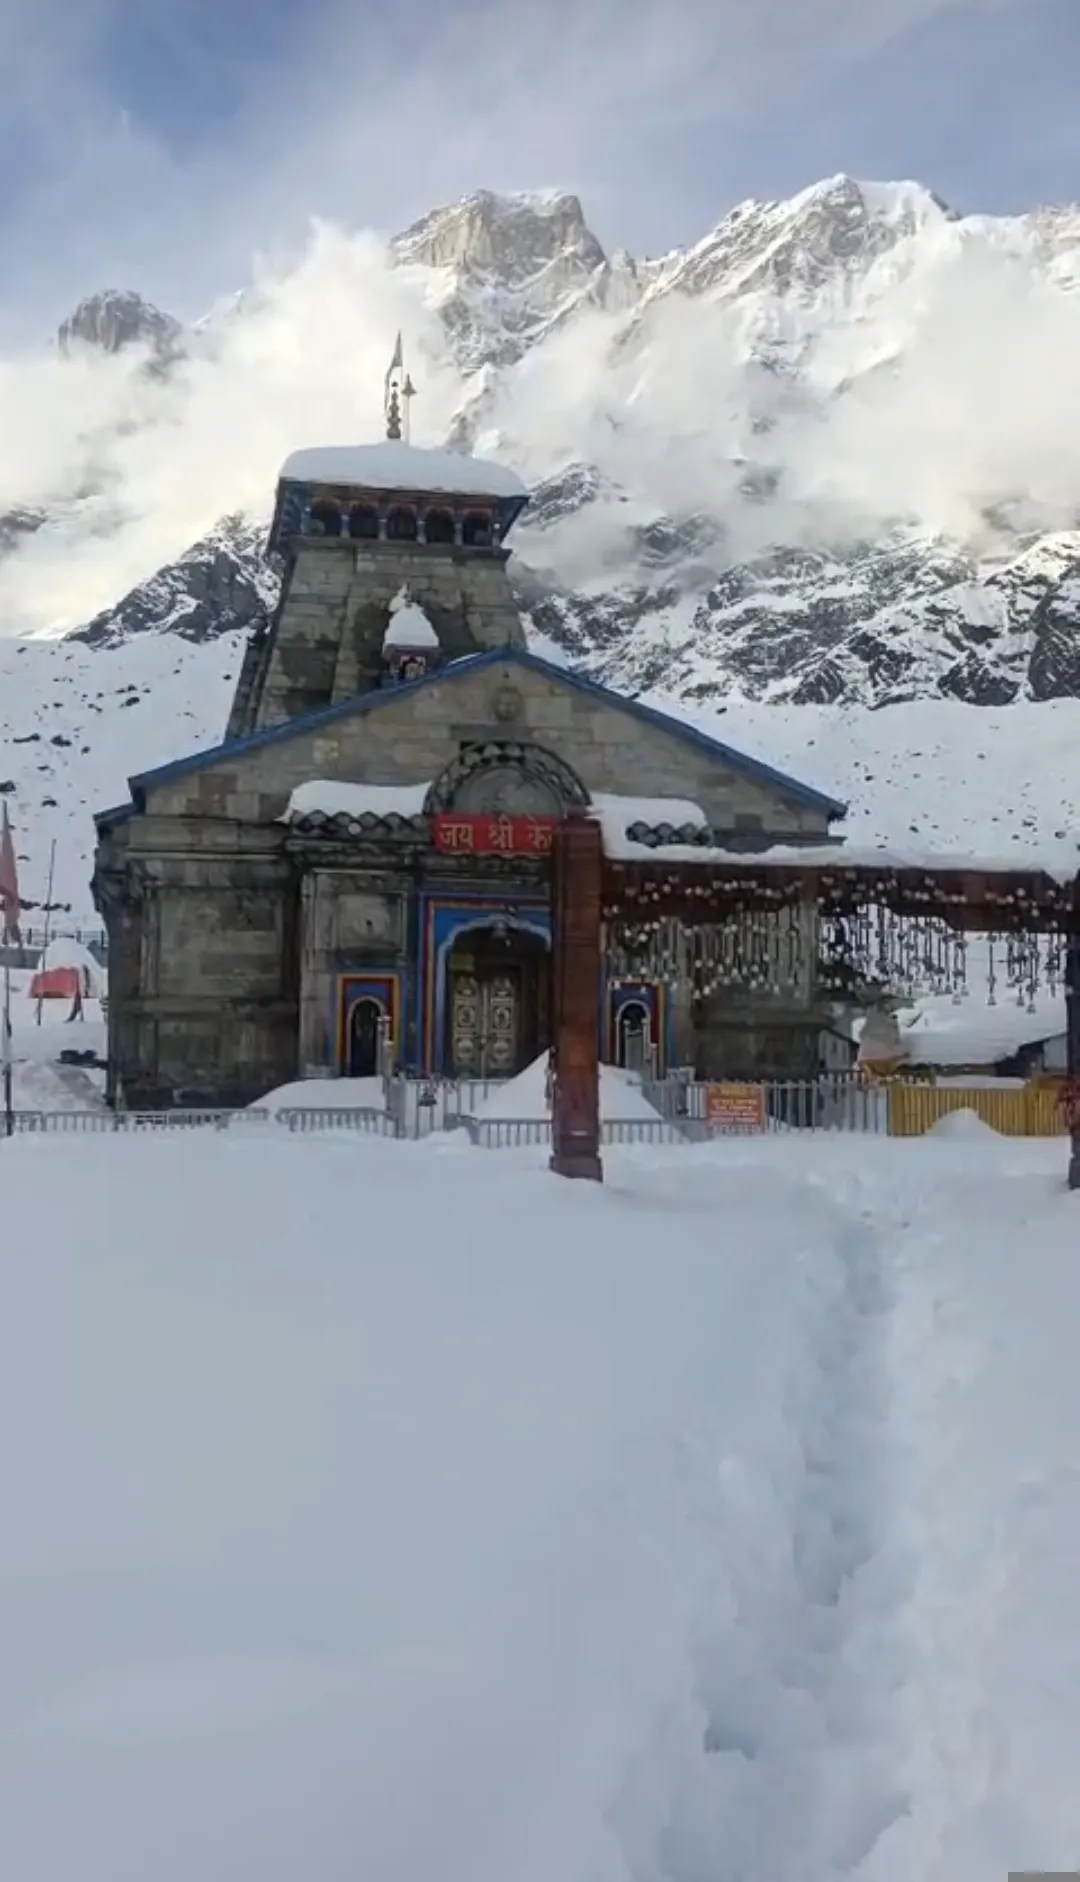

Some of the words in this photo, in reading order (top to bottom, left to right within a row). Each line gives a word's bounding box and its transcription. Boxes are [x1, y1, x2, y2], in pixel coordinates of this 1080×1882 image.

[439, 822, 474, 849] जय
[488, 813, 514, 849] श्री
[527, 812, 552, 850] के
